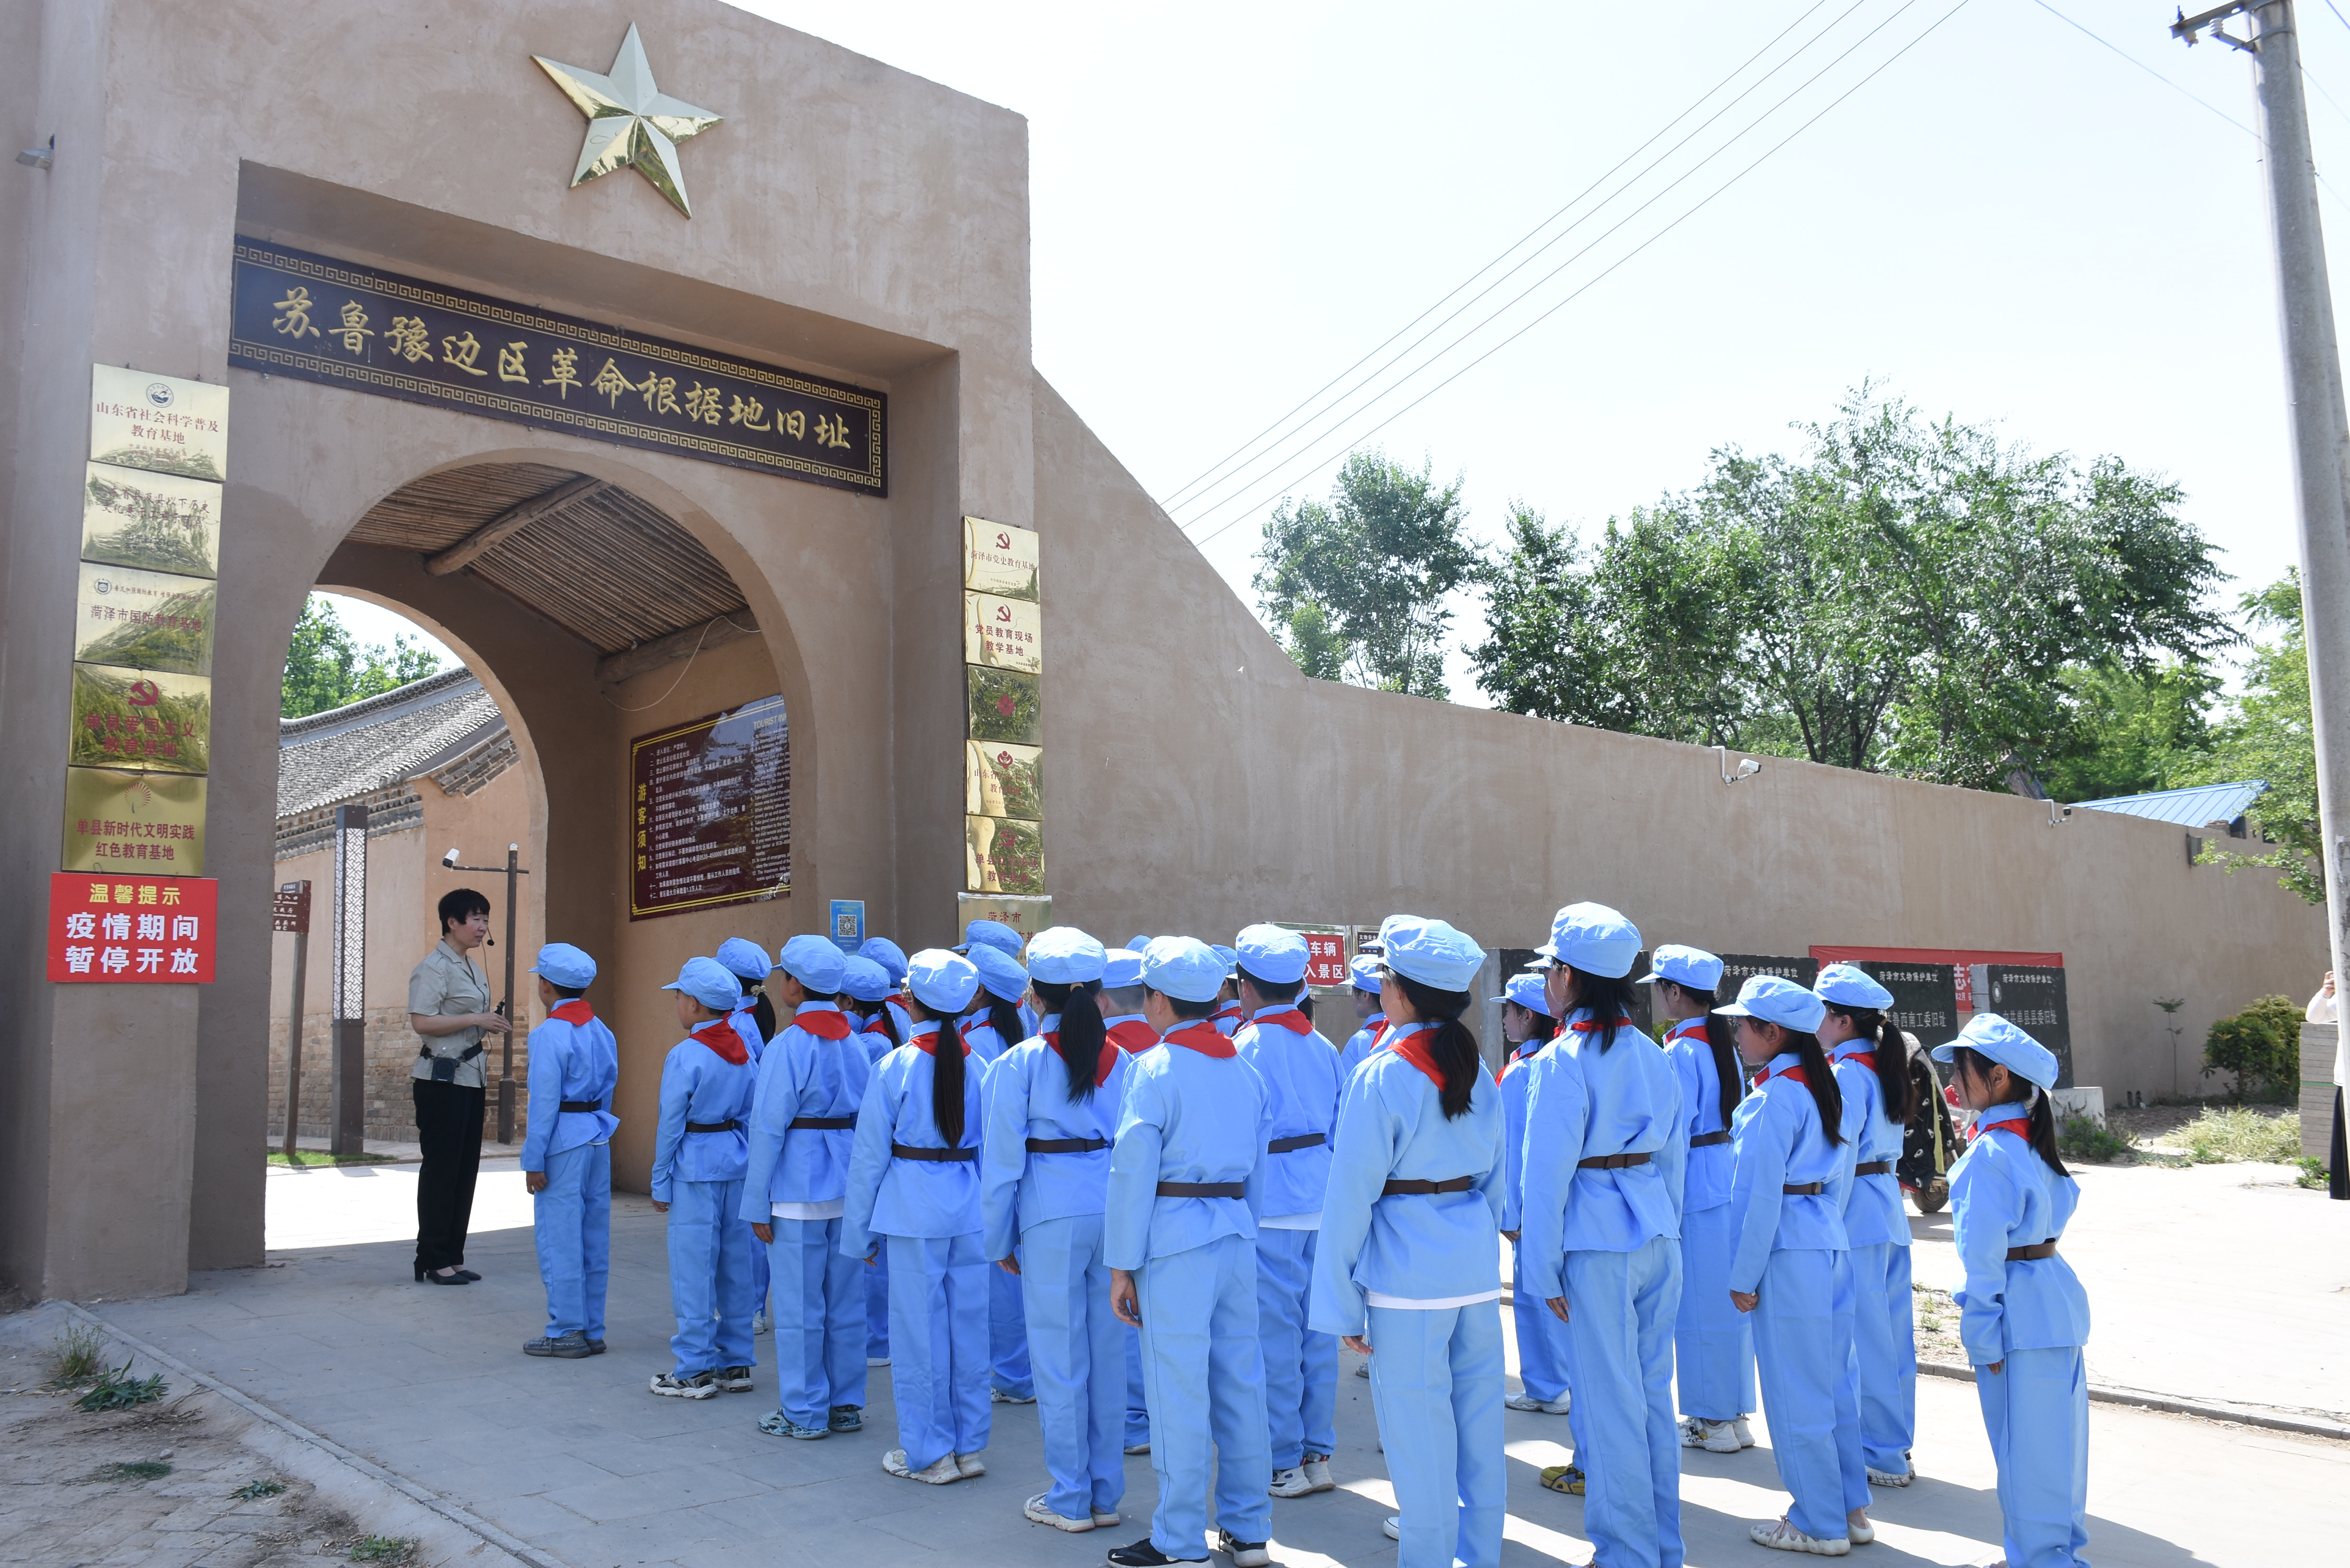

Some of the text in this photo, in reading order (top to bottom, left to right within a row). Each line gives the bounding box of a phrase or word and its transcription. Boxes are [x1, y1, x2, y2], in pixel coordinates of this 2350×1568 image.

[272, 286, 851, 449] 苏鲁豫边区革命根据地旧址
[96, 401, 219, 433] 山东省社会科学普及
[131, 424, 185, 444] 教育基地
[99, 484, 210, 514] 山东省县及县以下历史
[102, 502, 203, 526] 文化展示工程示范点
[971, 550, 1035, 572] 菏泽市党史教育基地
[91, 605, 202, 632] 菏泽市国防教育基地
[975, 624, 1033, 643] 党员教育现场
[985, 640, 1024, 656] 教学基地
[85, 712, 195, 737] 单县爱国主义
[753, 715, 777, 730] TOURIST
[104, 736, 178, 758] 教育基地
[76, 820, 195, 840] 单县新时代文明实践
[637, 783, 647, 872] 游客须知
[95, 841, 175, 861] 红色教育基地
[987, 870, 1029, 884] 教育基地
[89, 882, 181, 906] 温馨提示
[66, 912, 199, 941] 疫情期间
[988, 911, 1021, 924] 菏泽市
[1310, 941, 1336, 956] 车辆
[65, 946, 199, 974] 暂停开放
[1305, 964, 1344, 979] 入景区
[1724, 965, 1798, 978] 菏泽市文物保护单位
[1880, 971, 1938, 982] 菏泽市文物保护单位
[2002, 974, 2052, 984] 菏泽市文物保护单位
[2002, 1009, 2057, 1025] 中共单县县委旧址
